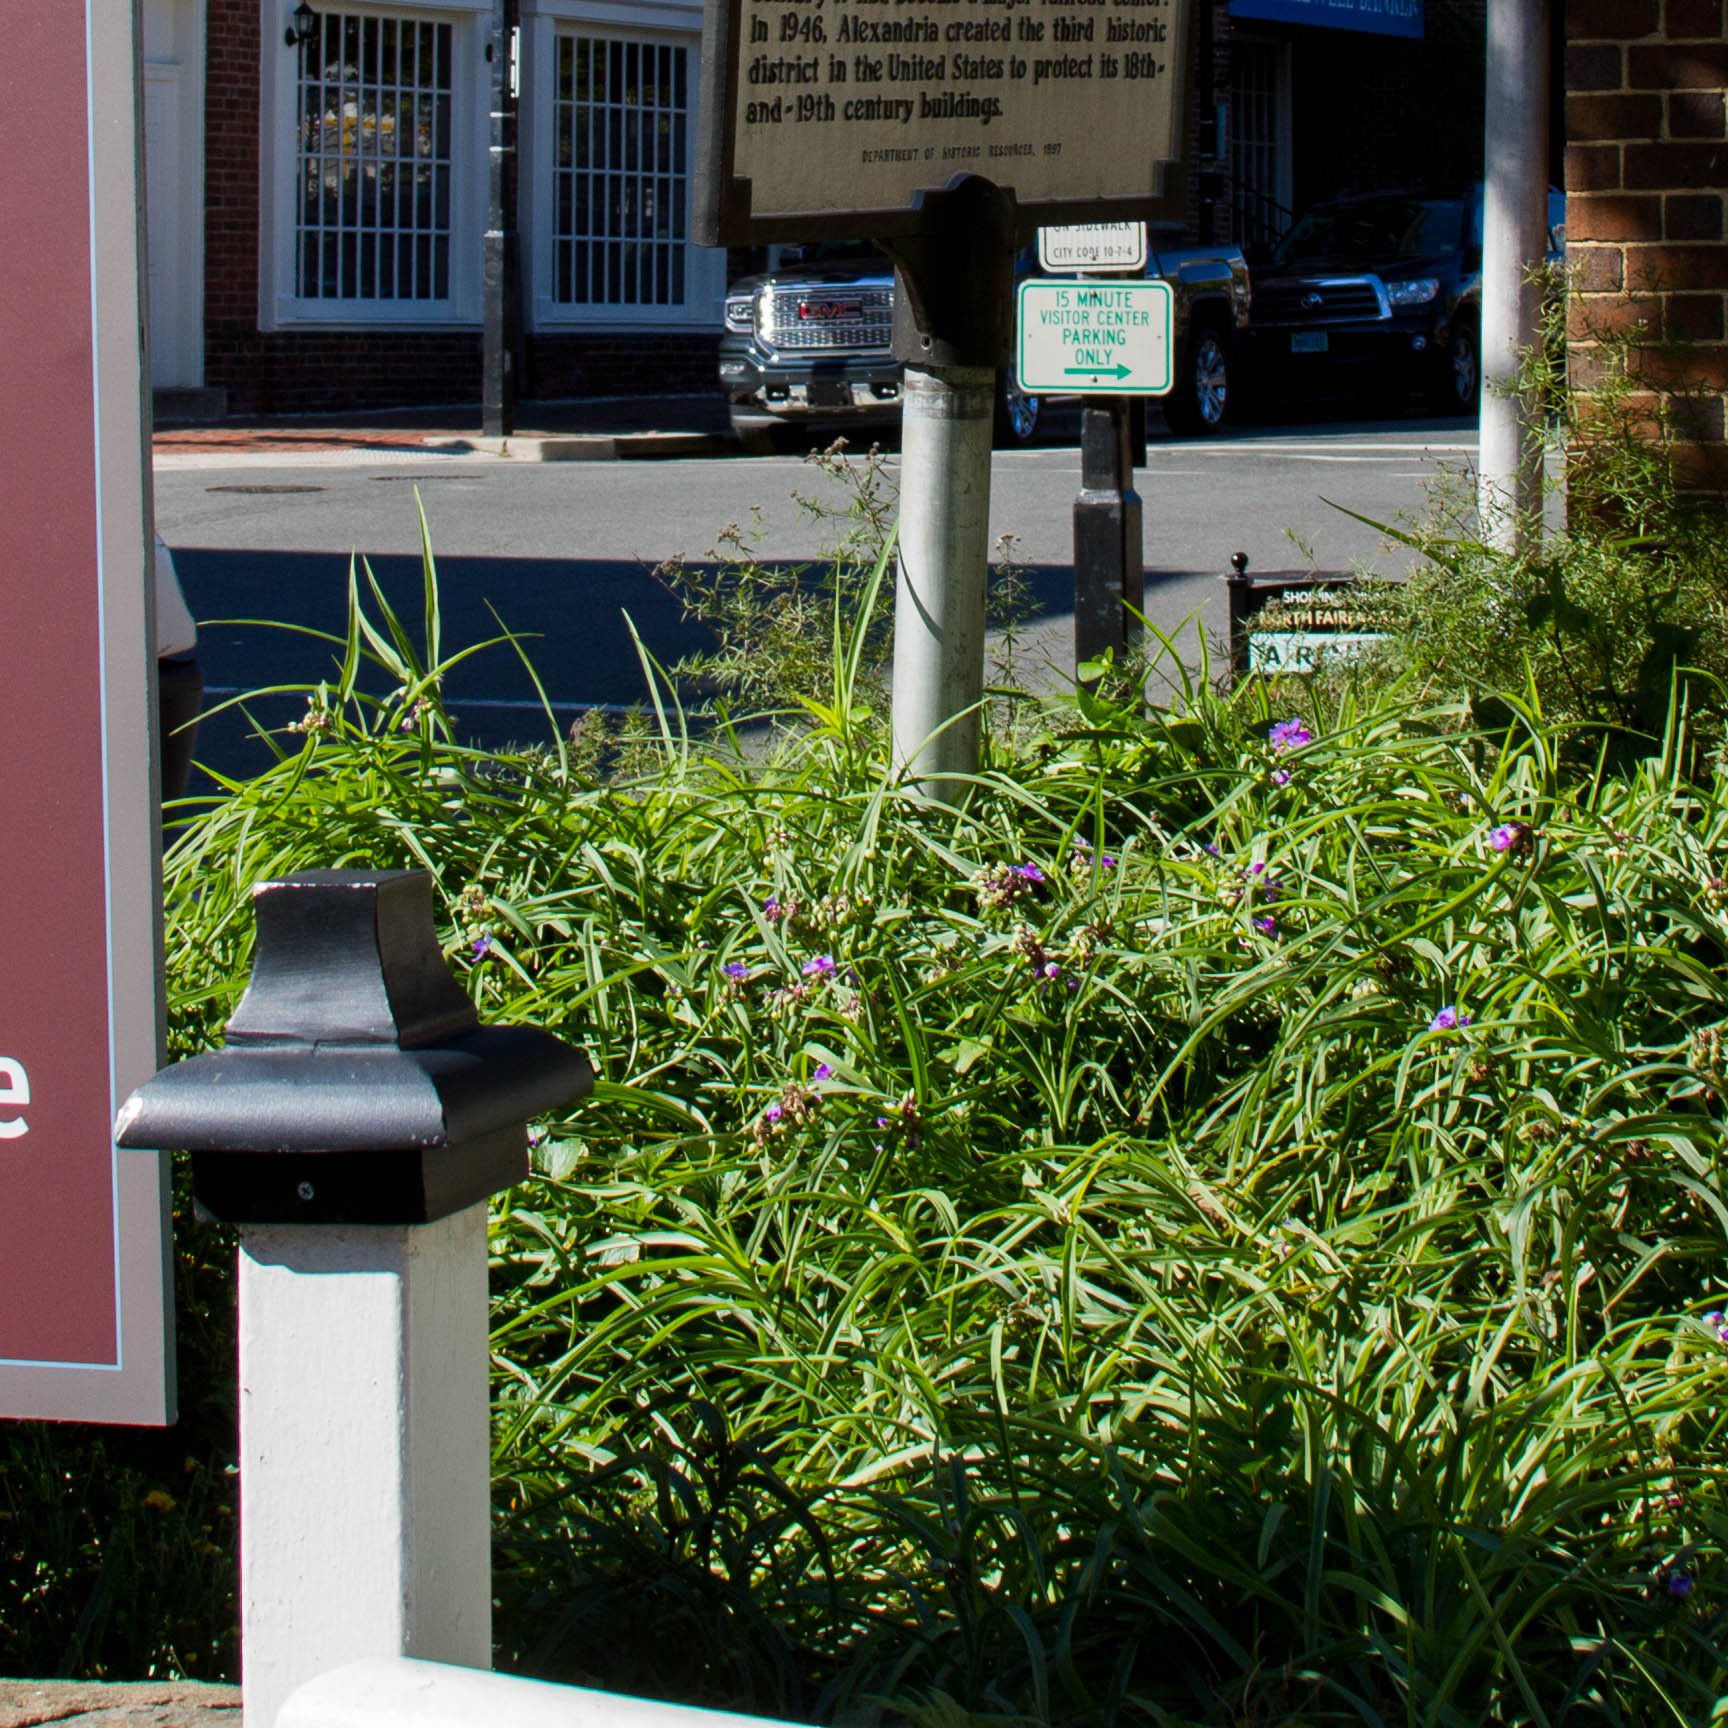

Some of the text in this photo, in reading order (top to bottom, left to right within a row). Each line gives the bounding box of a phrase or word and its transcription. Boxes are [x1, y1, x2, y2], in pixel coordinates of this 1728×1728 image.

[749, 12, 1167, 44] In 1946, Alexandria created the third historic
[746, 53, 820, 85] district
[827, 52, 847, 83] in
[853, 53, 883, 83] the
[886, 52, 946, 82] United
[950, 51, 1004, 80] States
[1008, 53, 1027, 80] to
[1032, 52, 1093, 86] protect
[1098, 51, 1119, 79] its
[841, 93, 915, 124] century
[917, 90, 1003, 126] buildings.
[1053, 247, 1072, 259] CITY
[1076, 247, 1099, 258] CODE
[1056, 291, 1133, 308] 15 MINUTE
[801, 301, 862, 320] GMC
[1040, 309, 1150, 327] VISITOR CENTER
[1063, 329, 1126, 345] PARKING
[1075, 348, 1113, 365] ONLY
